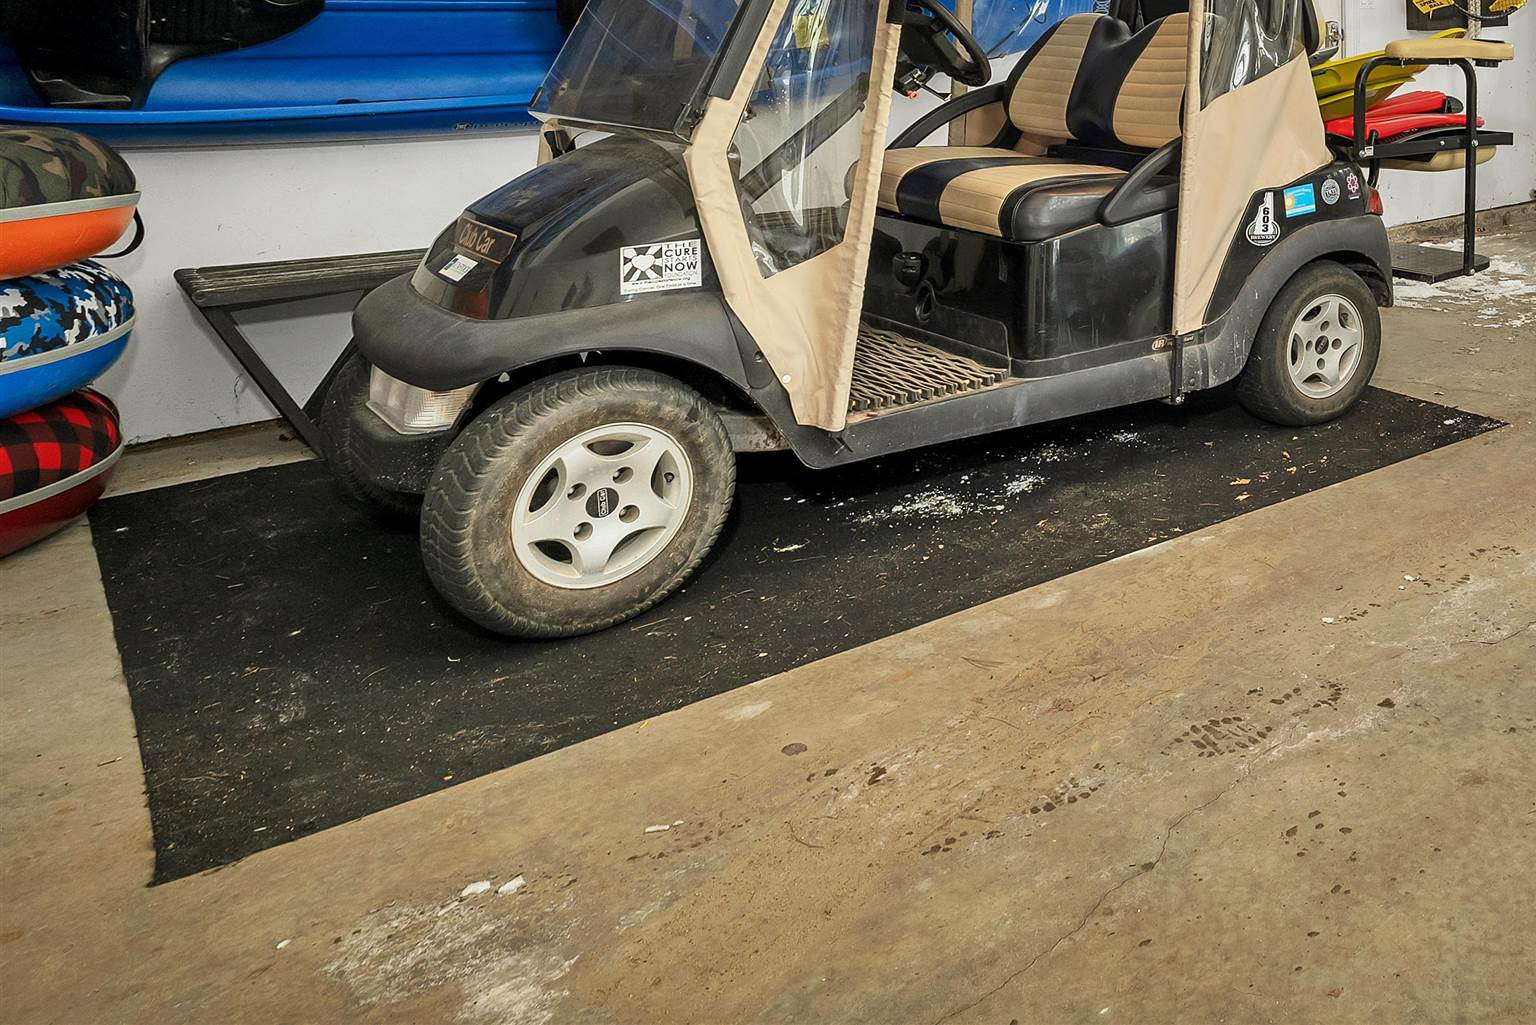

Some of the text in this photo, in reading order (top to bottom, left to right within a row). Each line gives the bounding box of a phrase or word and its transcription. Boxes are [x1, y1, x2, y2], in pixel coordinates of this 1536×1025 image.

[475, 229, 496, 254] Car
[664, 241, 698, 249] THE
[664, 247, 698, 258] CURE
[664, 261, 698, 273] NOW
